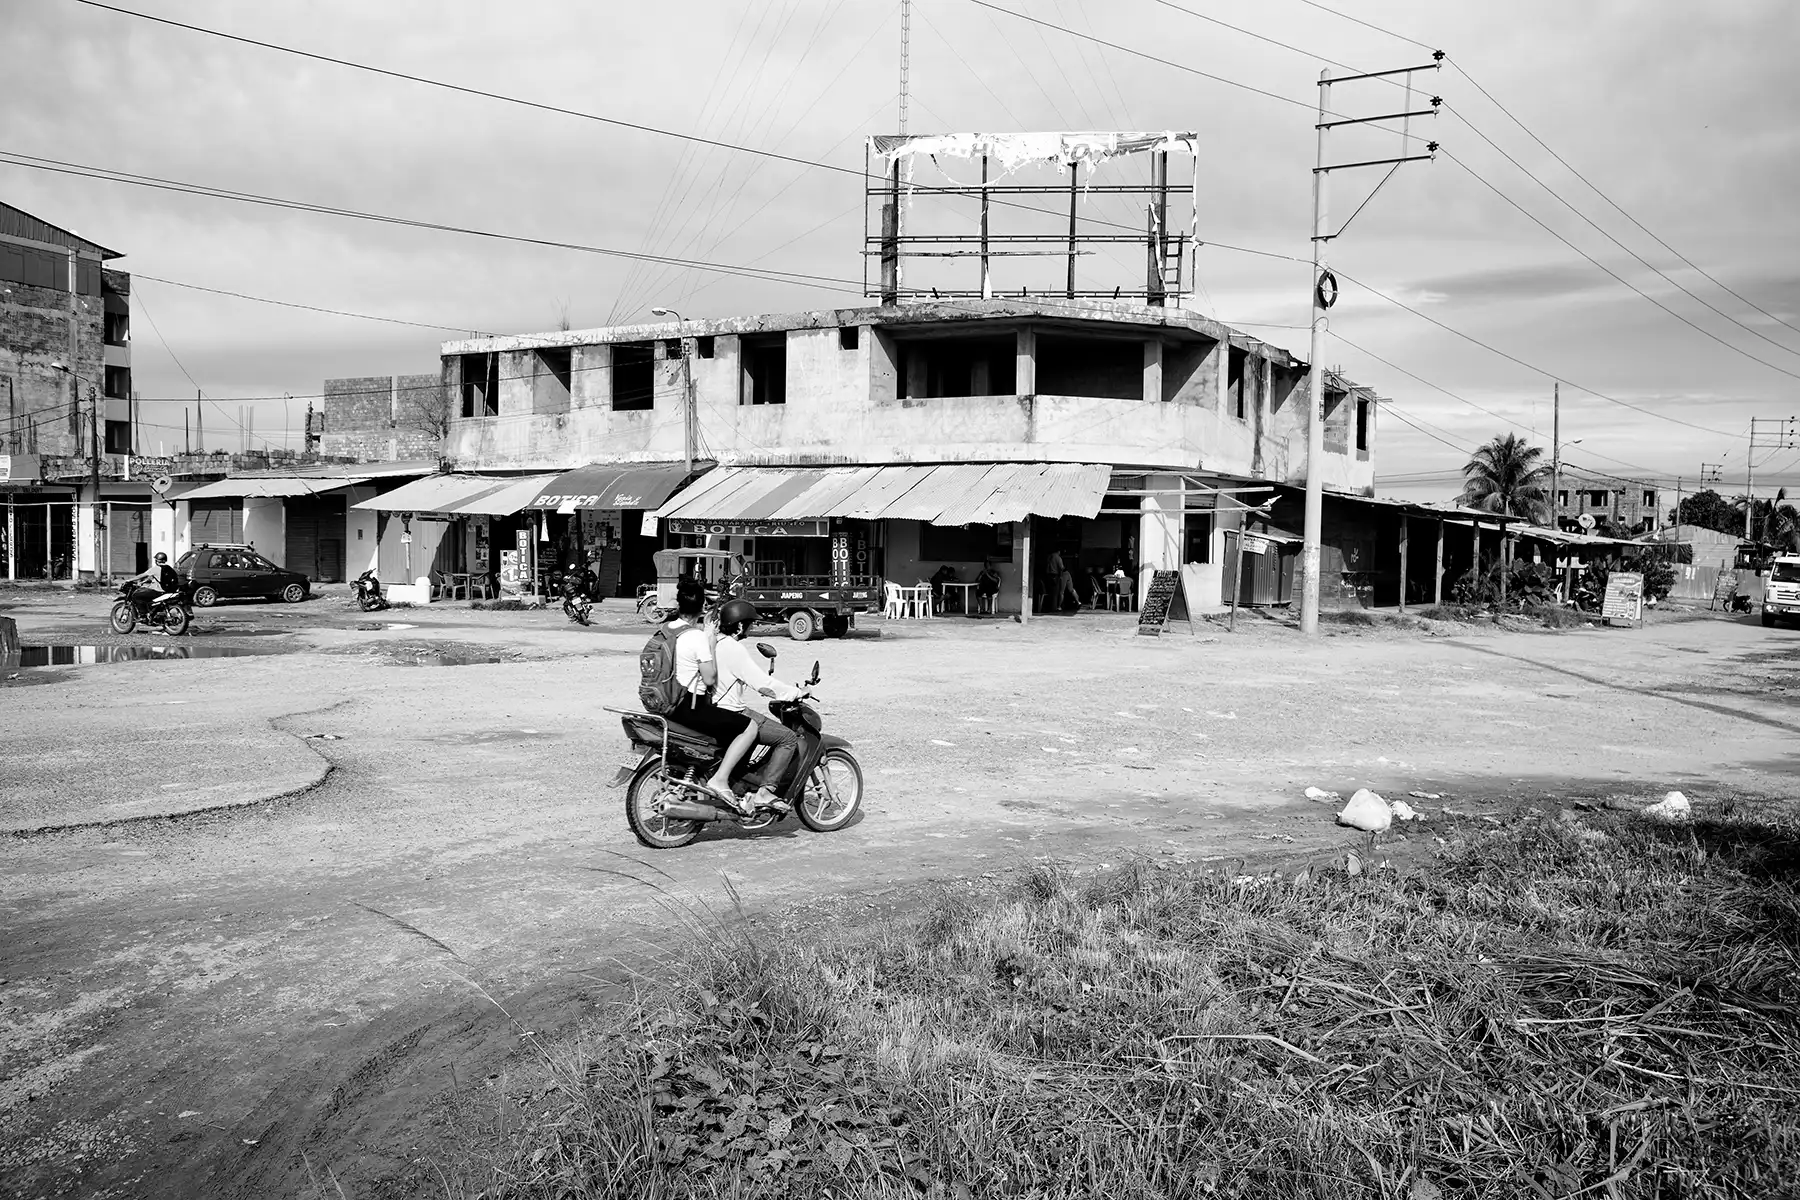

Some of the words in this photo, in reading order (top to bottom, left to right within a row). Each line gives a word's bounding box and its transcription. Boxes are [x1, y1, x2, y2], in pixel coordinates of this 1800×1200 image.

[129, 457, 170, 466] POLLERIA
[694, 525, 788, 534] BOTICA
[518, 531, 528, 579] BOTICA
